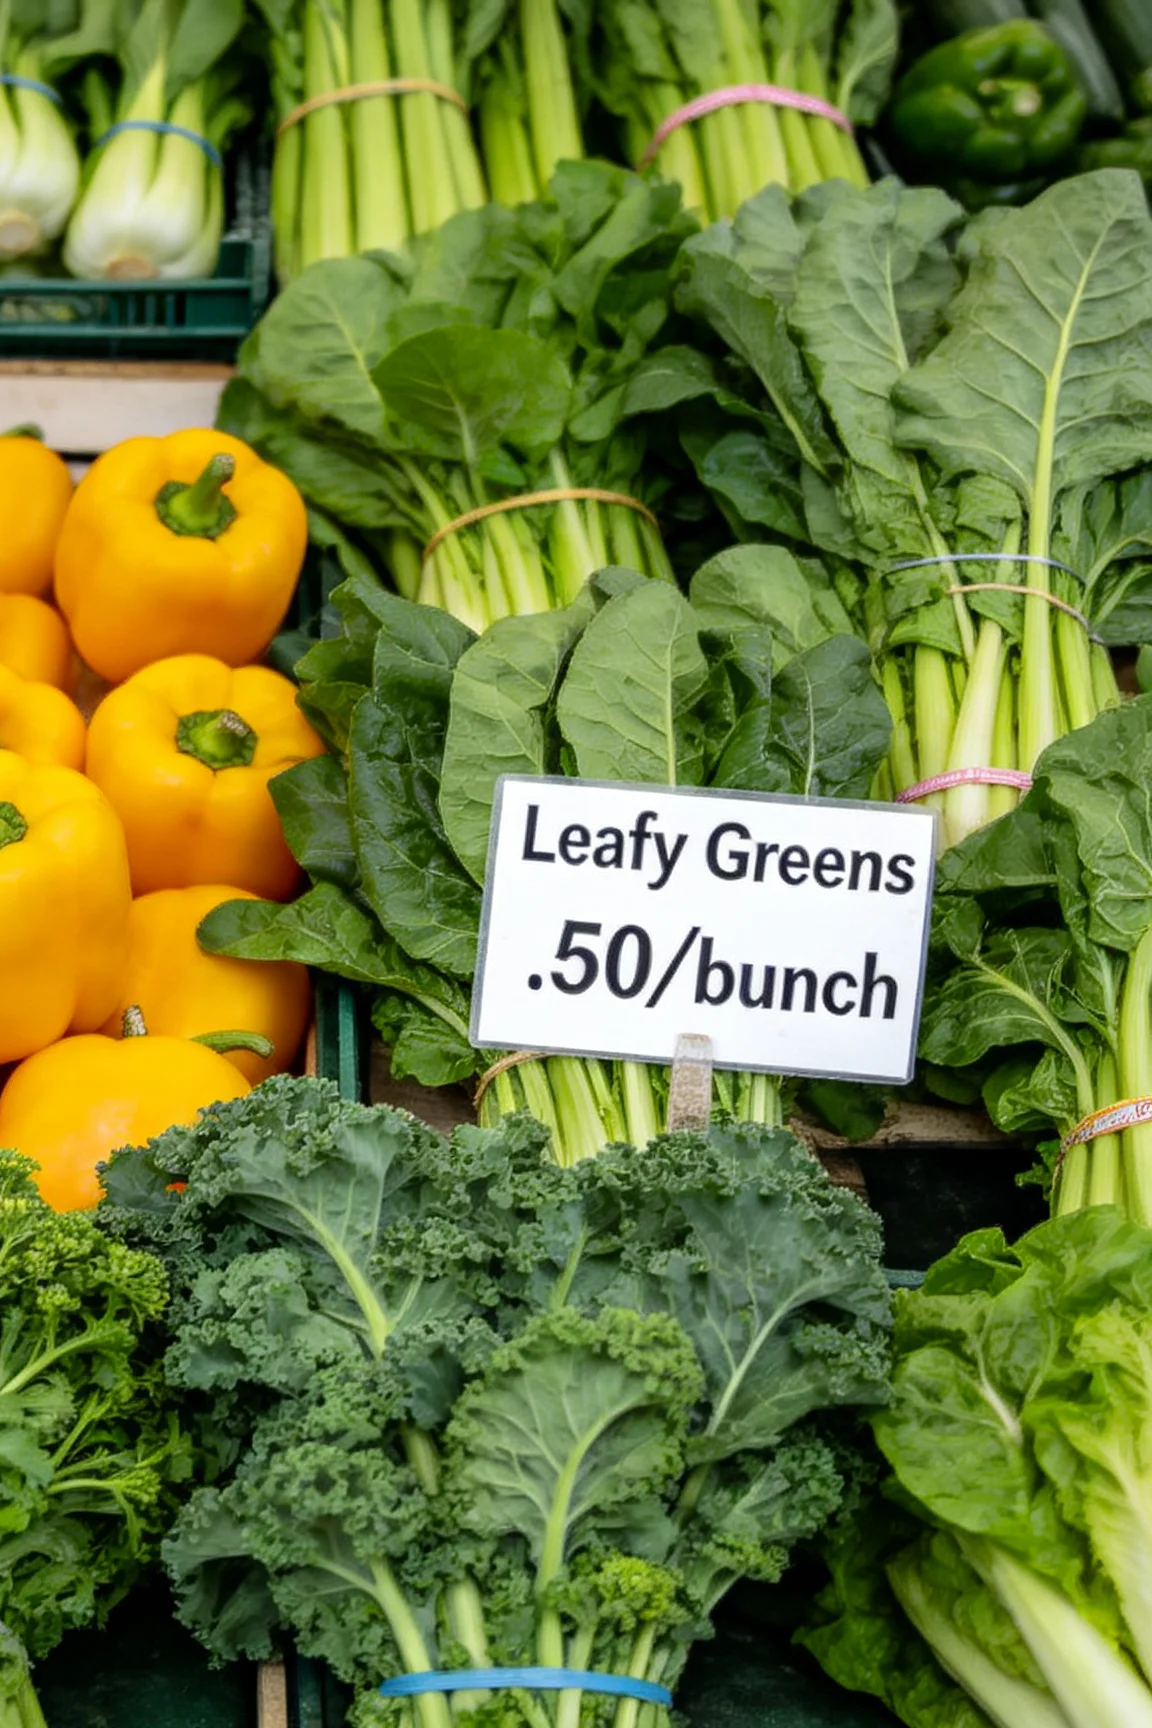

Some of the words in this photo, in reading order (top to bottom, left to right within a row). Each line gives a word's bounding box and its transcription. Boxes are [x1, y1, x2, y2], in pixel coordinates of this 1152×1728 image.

[522, 804, 688, 891] Leafy
[706, 822, 915, 895] Greens
[528, 919, 898, 1020] .50/bunch
